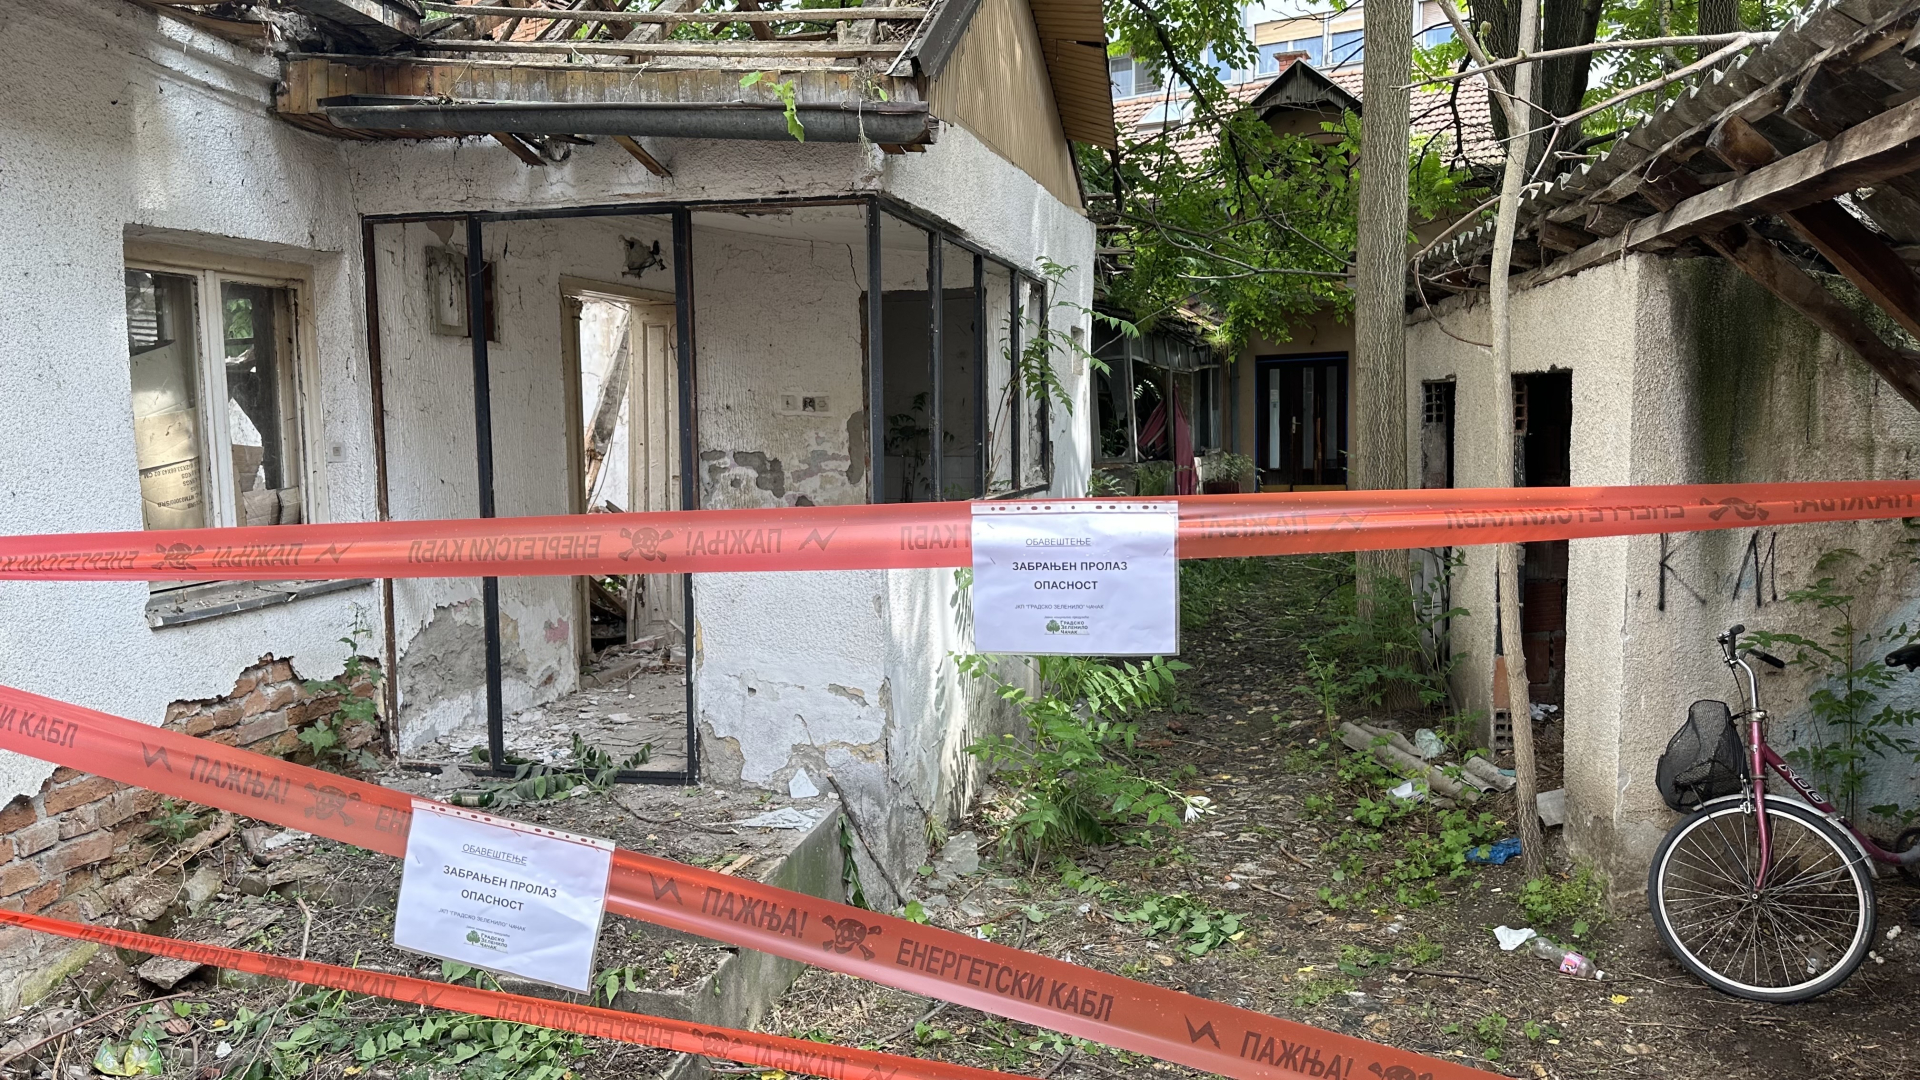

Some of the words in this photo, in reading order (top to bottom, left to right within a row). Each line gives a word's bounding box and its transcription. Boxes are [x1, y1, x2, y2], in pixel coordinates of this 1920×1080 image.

[1025, 537, 1092, 546] ОБАВЕШТЕЊЕ
[1012, 561, 1077, 571] ЗАБРАЊЕН
[1080, 561, 1128, 571] ПРОЛАЗ
[1034, 580, 1098, 590] ОПАСНОСТ
[19, 709, 78, 748] КАБЛ
[189, 754, 292, 805] ПАЖЊА!
[462, 843, 528, 865] ОБАВЕШТЕЊЕ
[443, 865, 507, 888] ЗАБРАЊЕН
[510, 880, 557, 899] ПРОЛАЗ
[461, 889, 524, 911] ОПАСНОСТ
[701, 886, 808, 938] ПАЖЊА!
[895, 938, 1045, 1003] ЕНЕРГЕТСКИ
[1048, 980, 1114, 1021] КАБЛ
[1240, 1030, 1354, 1080] ПАЖЊА!
